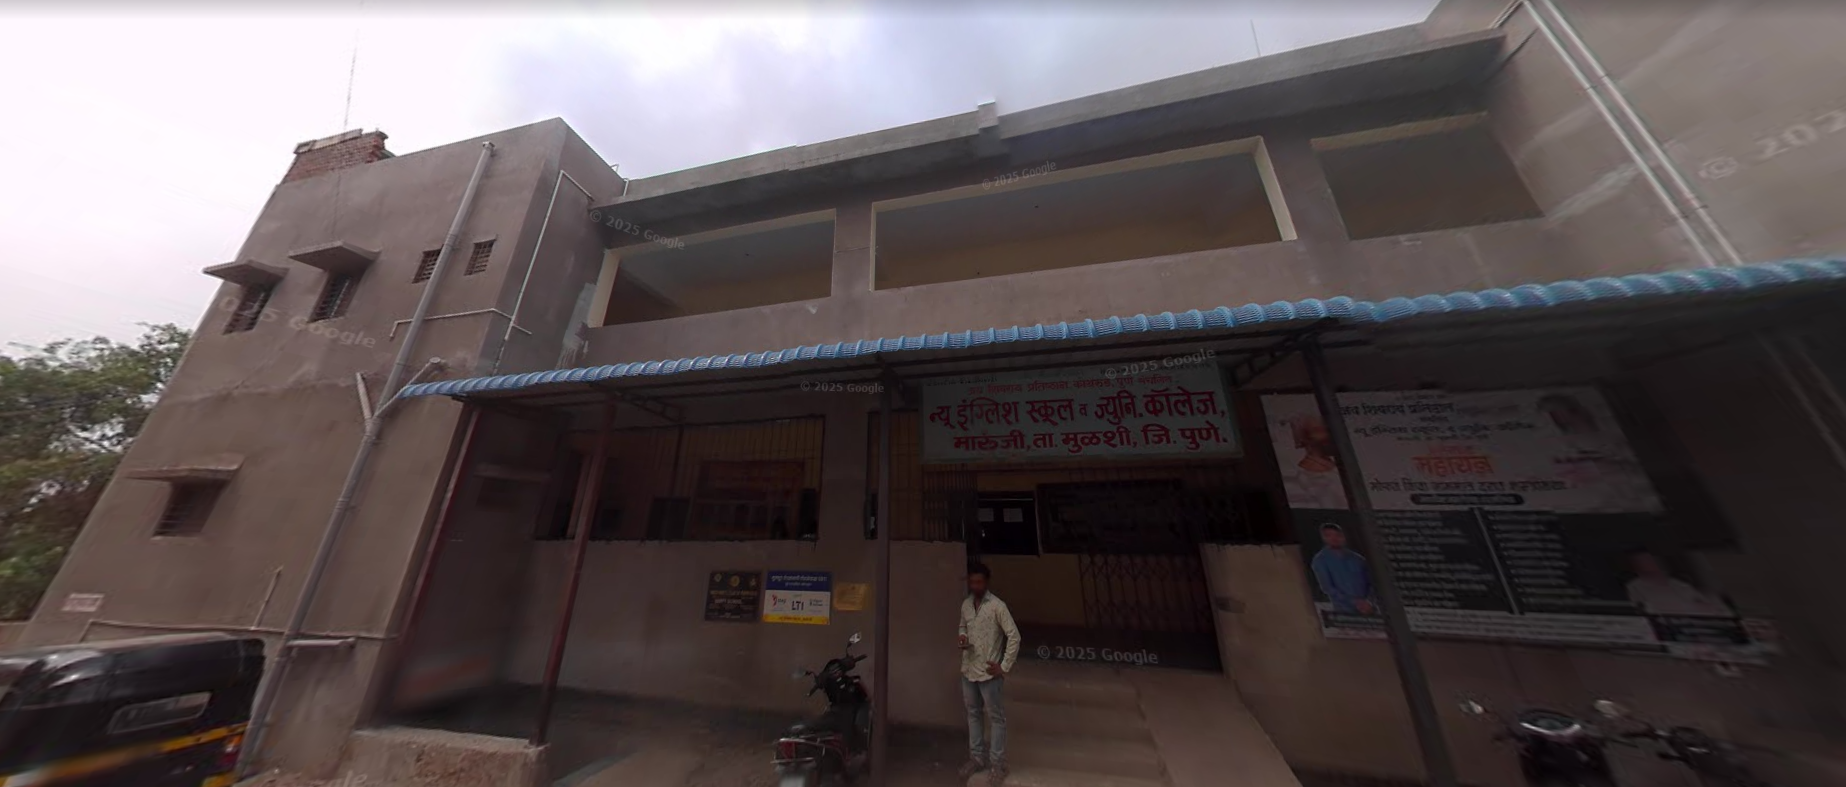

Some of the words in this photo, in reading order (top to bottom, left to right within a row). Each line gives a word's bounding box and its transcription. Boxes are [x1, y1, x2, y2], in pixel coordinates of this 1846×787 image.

[928, 403, 955, 429] न्यू
[957, 396, 1020, 431] इंग्लिश
[1025, 397, 1075, 426] स्कूल
[1079, 402, 1088, 417] व
[1143, 385, 1226, 419] कॉलेज,
[1033, 433, 1059, 449] ता.
[1059, 426, 1138, 454] मुळशी,
[1141, 422, 1177, 446] जि.
[1177, 419, 1230, 450] पुणे.
